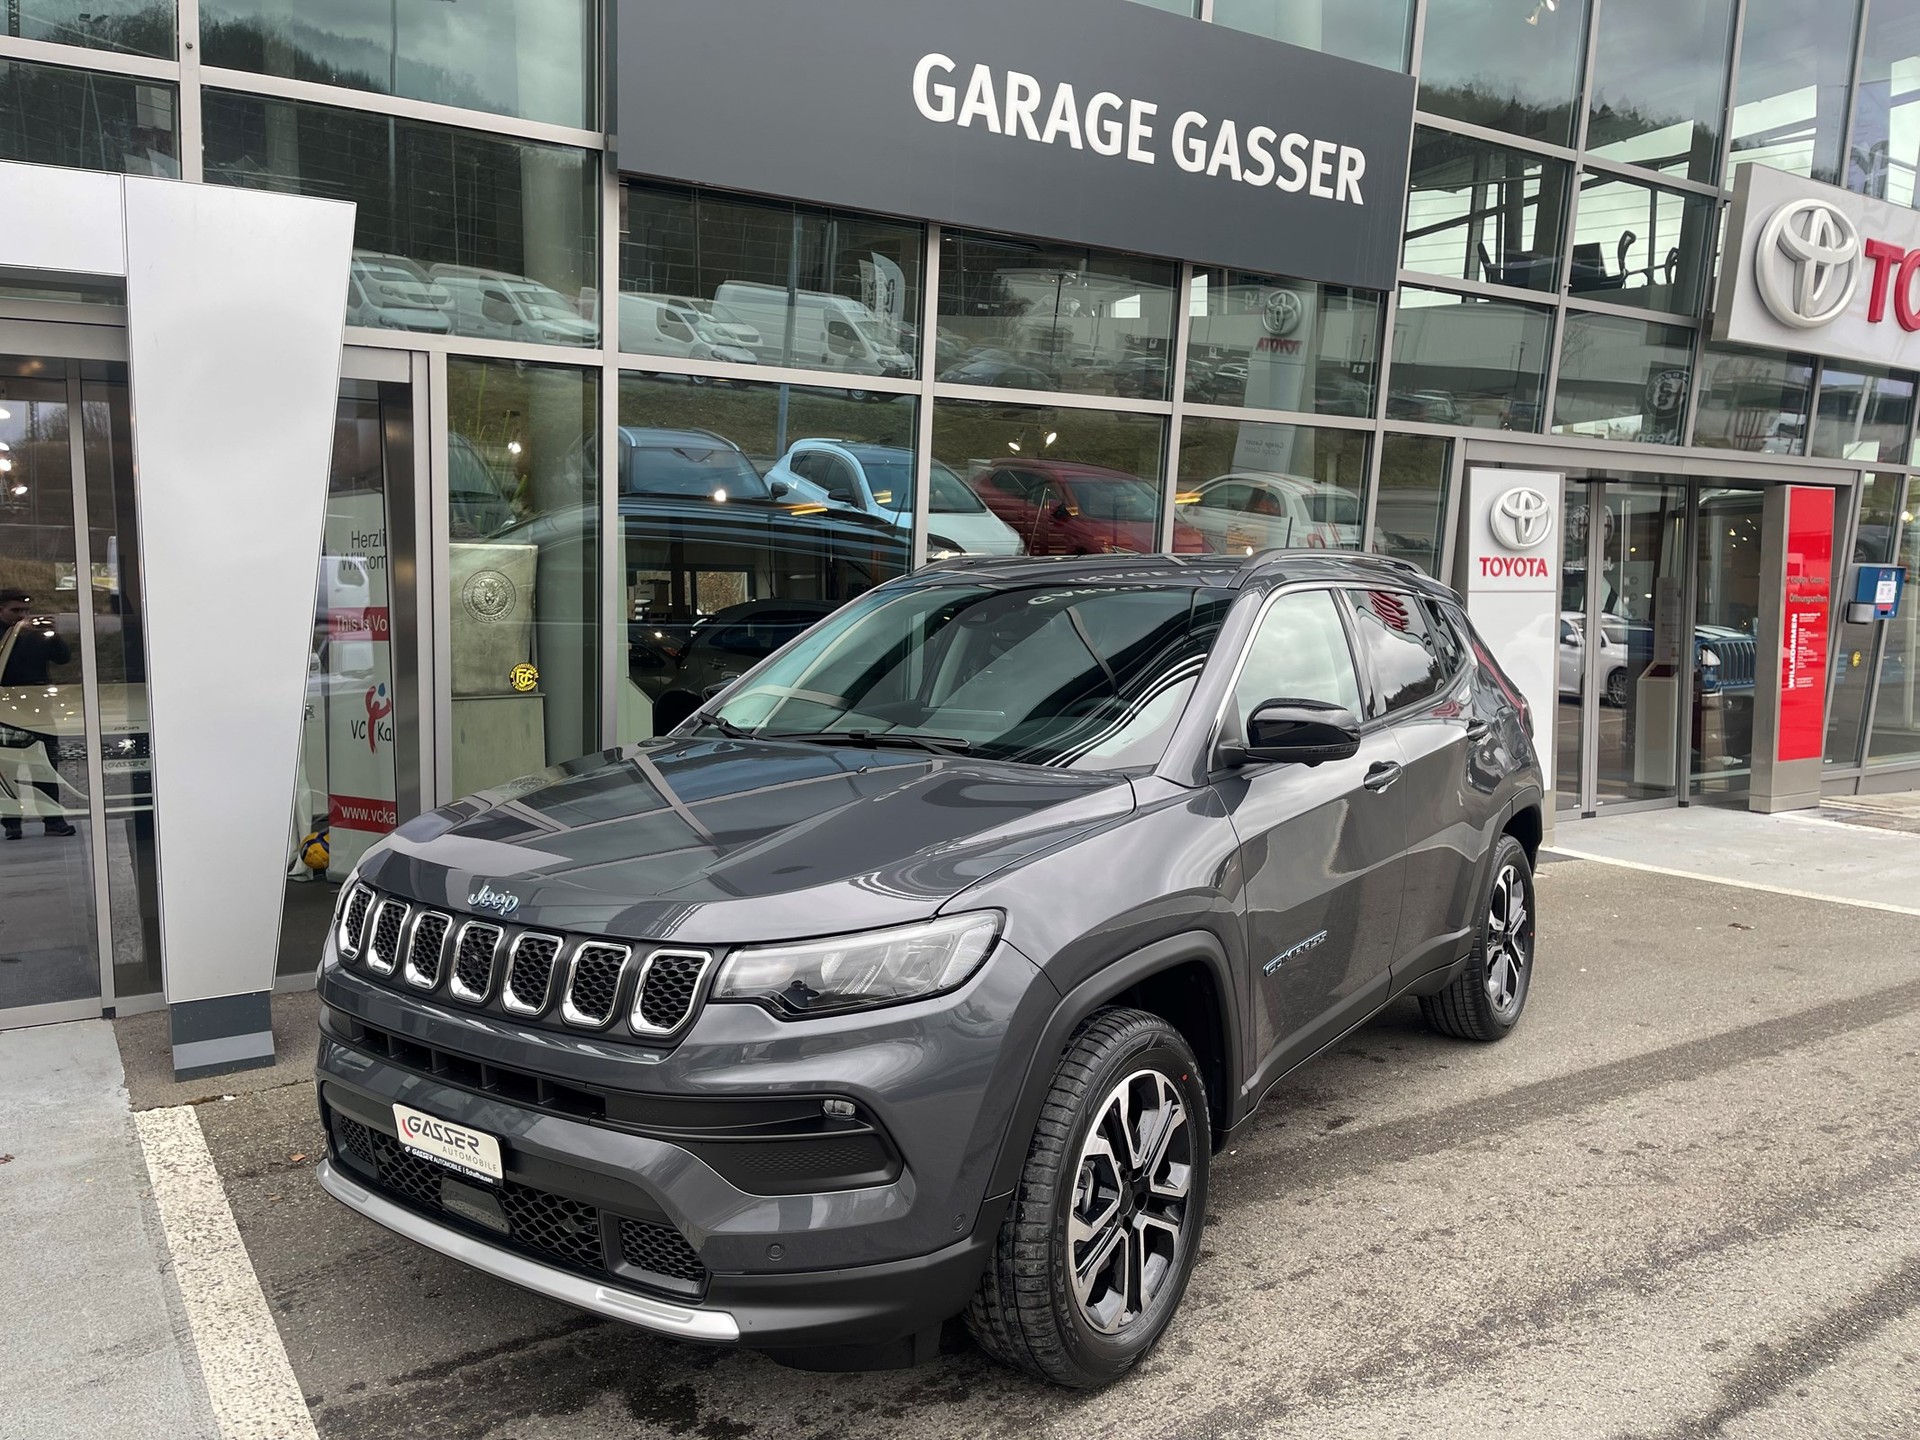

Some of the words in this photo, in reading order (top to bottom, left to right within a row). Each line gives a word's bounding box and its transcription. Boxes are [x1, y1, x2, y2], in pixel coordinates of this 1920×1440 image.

[912, 53, 1158, 165] GARAGE
[1172, 111, 1367, 206] GASSER
[1479, 556, 1549, 578] TOYOTA
[336, 615, 358, 632] This
[361, 616, 370, 631] is
[372, 615, 388, 632] Vo
[1788, 613, 1798, 688] WILLKOMMEN
[351, 720, 366, 740] VC
[378, 721, 392, 742] Ka
[341, 805, 397, 825] www.vcka
[467, 885, 520, 916] Jeep
[1263, 930, 1328, 977] COMPASS
[407, 1115, 480, 1156] GASSER
[412, 1148, 434, 1161] GASSER
[434, 1156, 462, 1173] AUTOMOBILE
[466, 1168, 494, 1184] Schaffhausen
[442, 1146, 498, 1173] AUTOMOBILE
